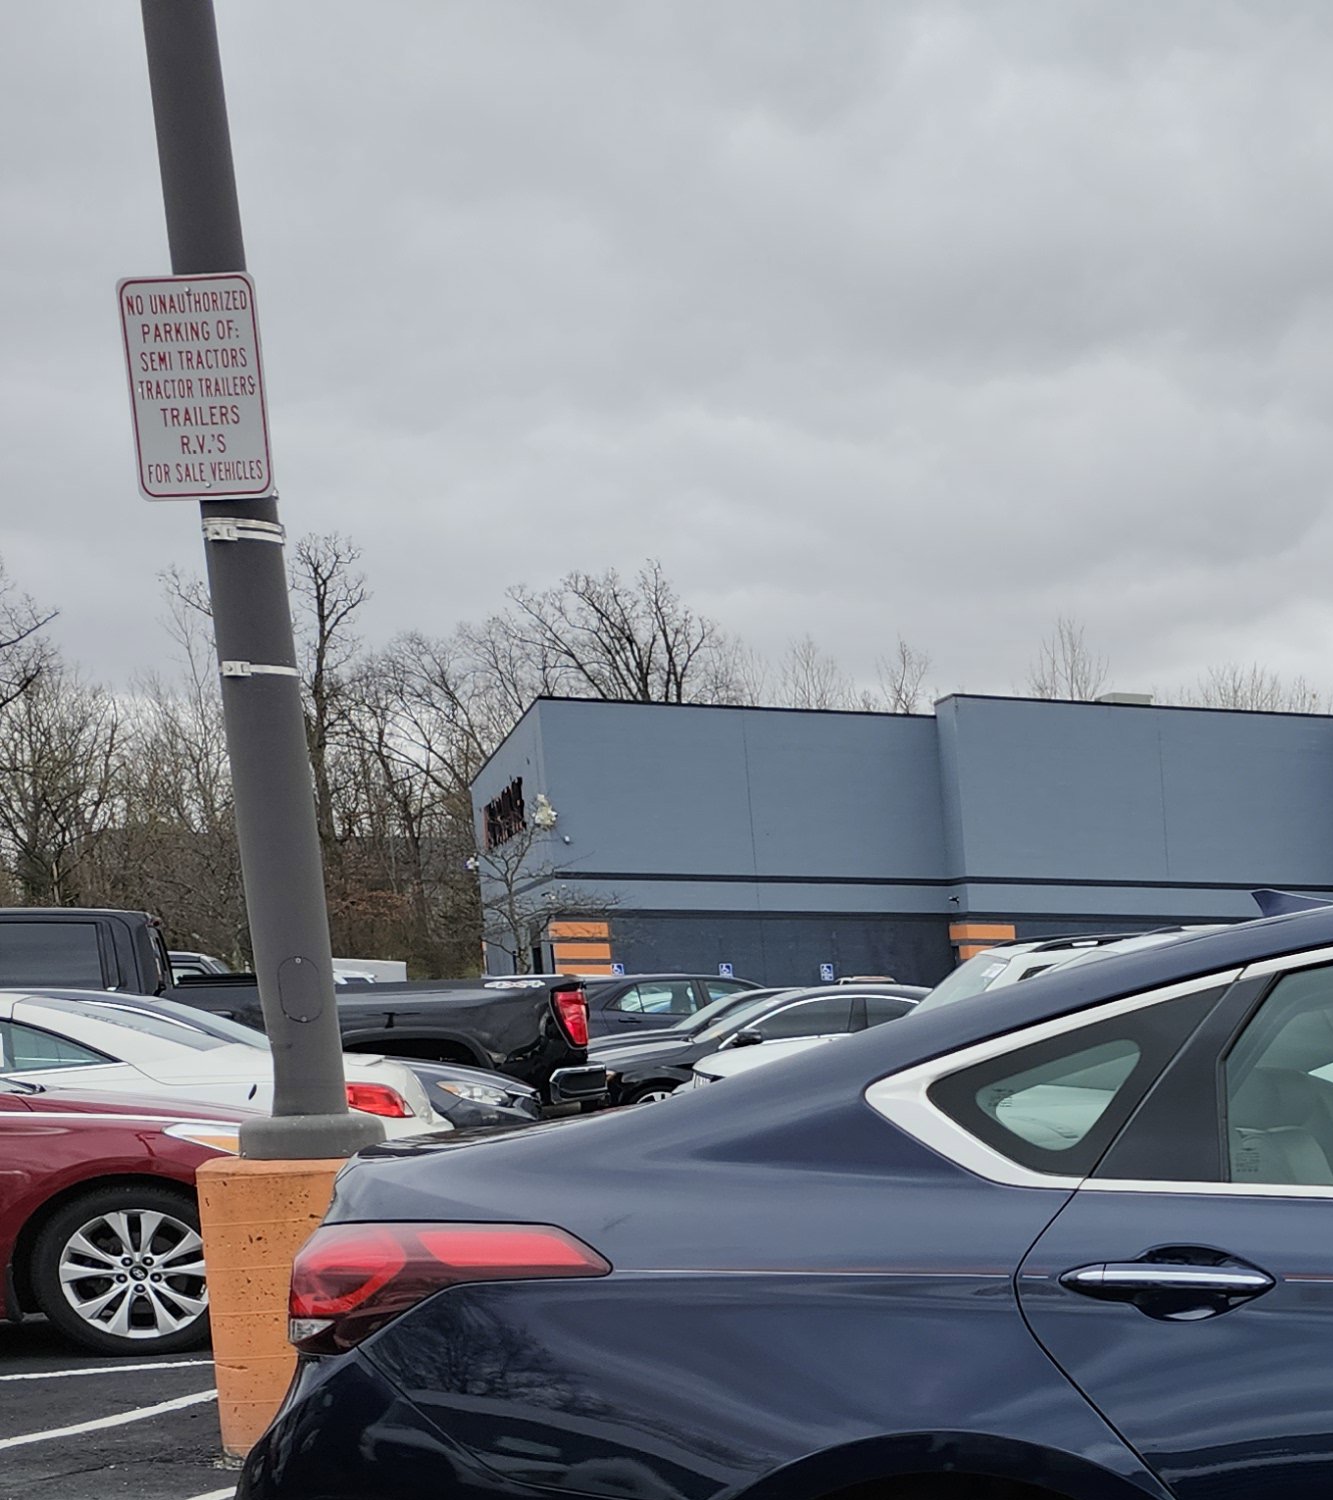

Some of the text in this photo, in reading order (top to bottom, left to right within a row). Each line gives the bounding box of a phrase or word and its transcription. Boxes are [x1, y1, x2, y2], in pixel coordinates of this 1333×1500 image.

[126, 290, 247, 316] NO UNAUTHORIZED
[141, 319, 240, 343] PARKING OF:
[140, 347, 247, 372] SEMI TRACTORS
[138, 375, 256, 400] TRACTOR TRAILERS
[160, 405, 240, 427] TRAILERS
[180, 433, 227, 455] R.V.'S
[148, 459, 263, 484] FOR SALE VEHICLES
